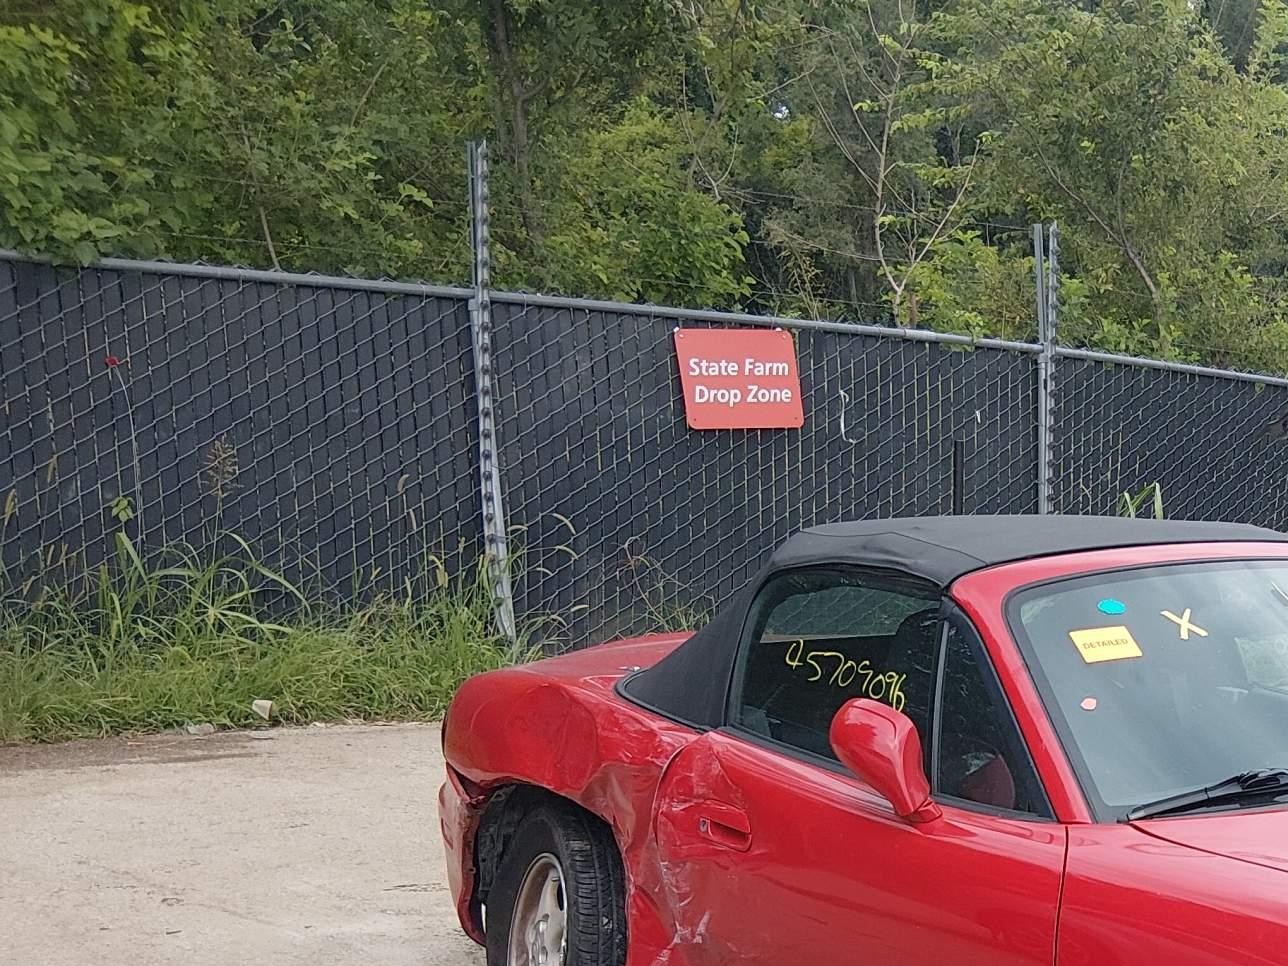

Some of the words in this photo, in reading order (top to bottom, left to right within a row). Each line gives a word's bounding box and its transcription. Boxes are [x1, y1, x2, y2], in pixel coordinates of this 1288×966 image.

[688, 358, 739, 376] State
[744, 358, 789, 376] Farm
[695, 385, 742, 407] Drop
[746, 385, 792, 403] Zone
[1082, 638, 1129, 650] DETAILED
[785, 639, 907, 713] 45709096
